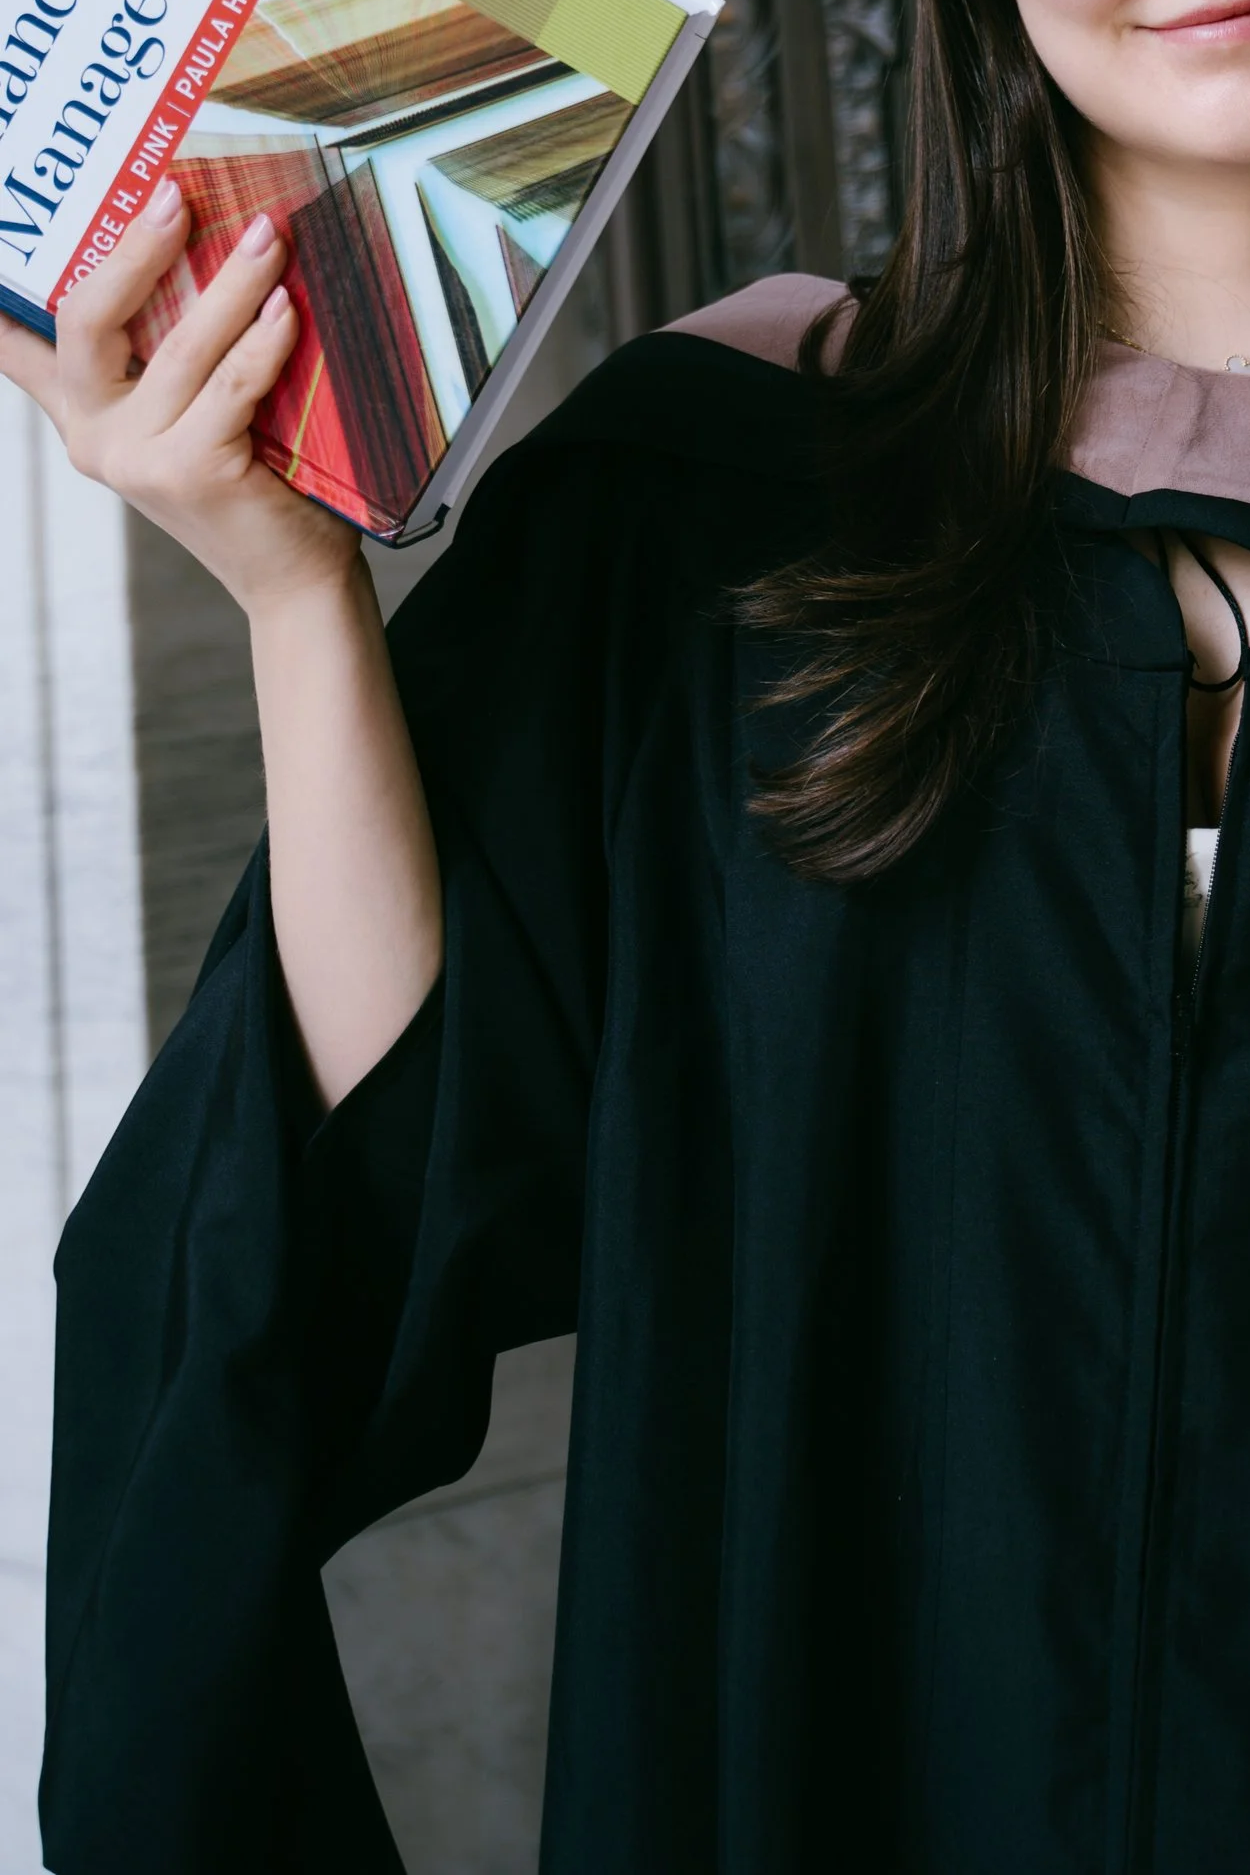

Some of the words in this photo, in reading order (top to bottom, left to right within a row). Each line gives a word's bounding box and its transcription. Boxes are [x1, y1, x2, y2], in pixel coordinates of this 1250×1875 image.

[57, 214, 126, 310] ORGE
[113, 190, 142, 213] H.
[131, 117, 178, 180] PINK
[176, 19, 234, 99] PAULA
